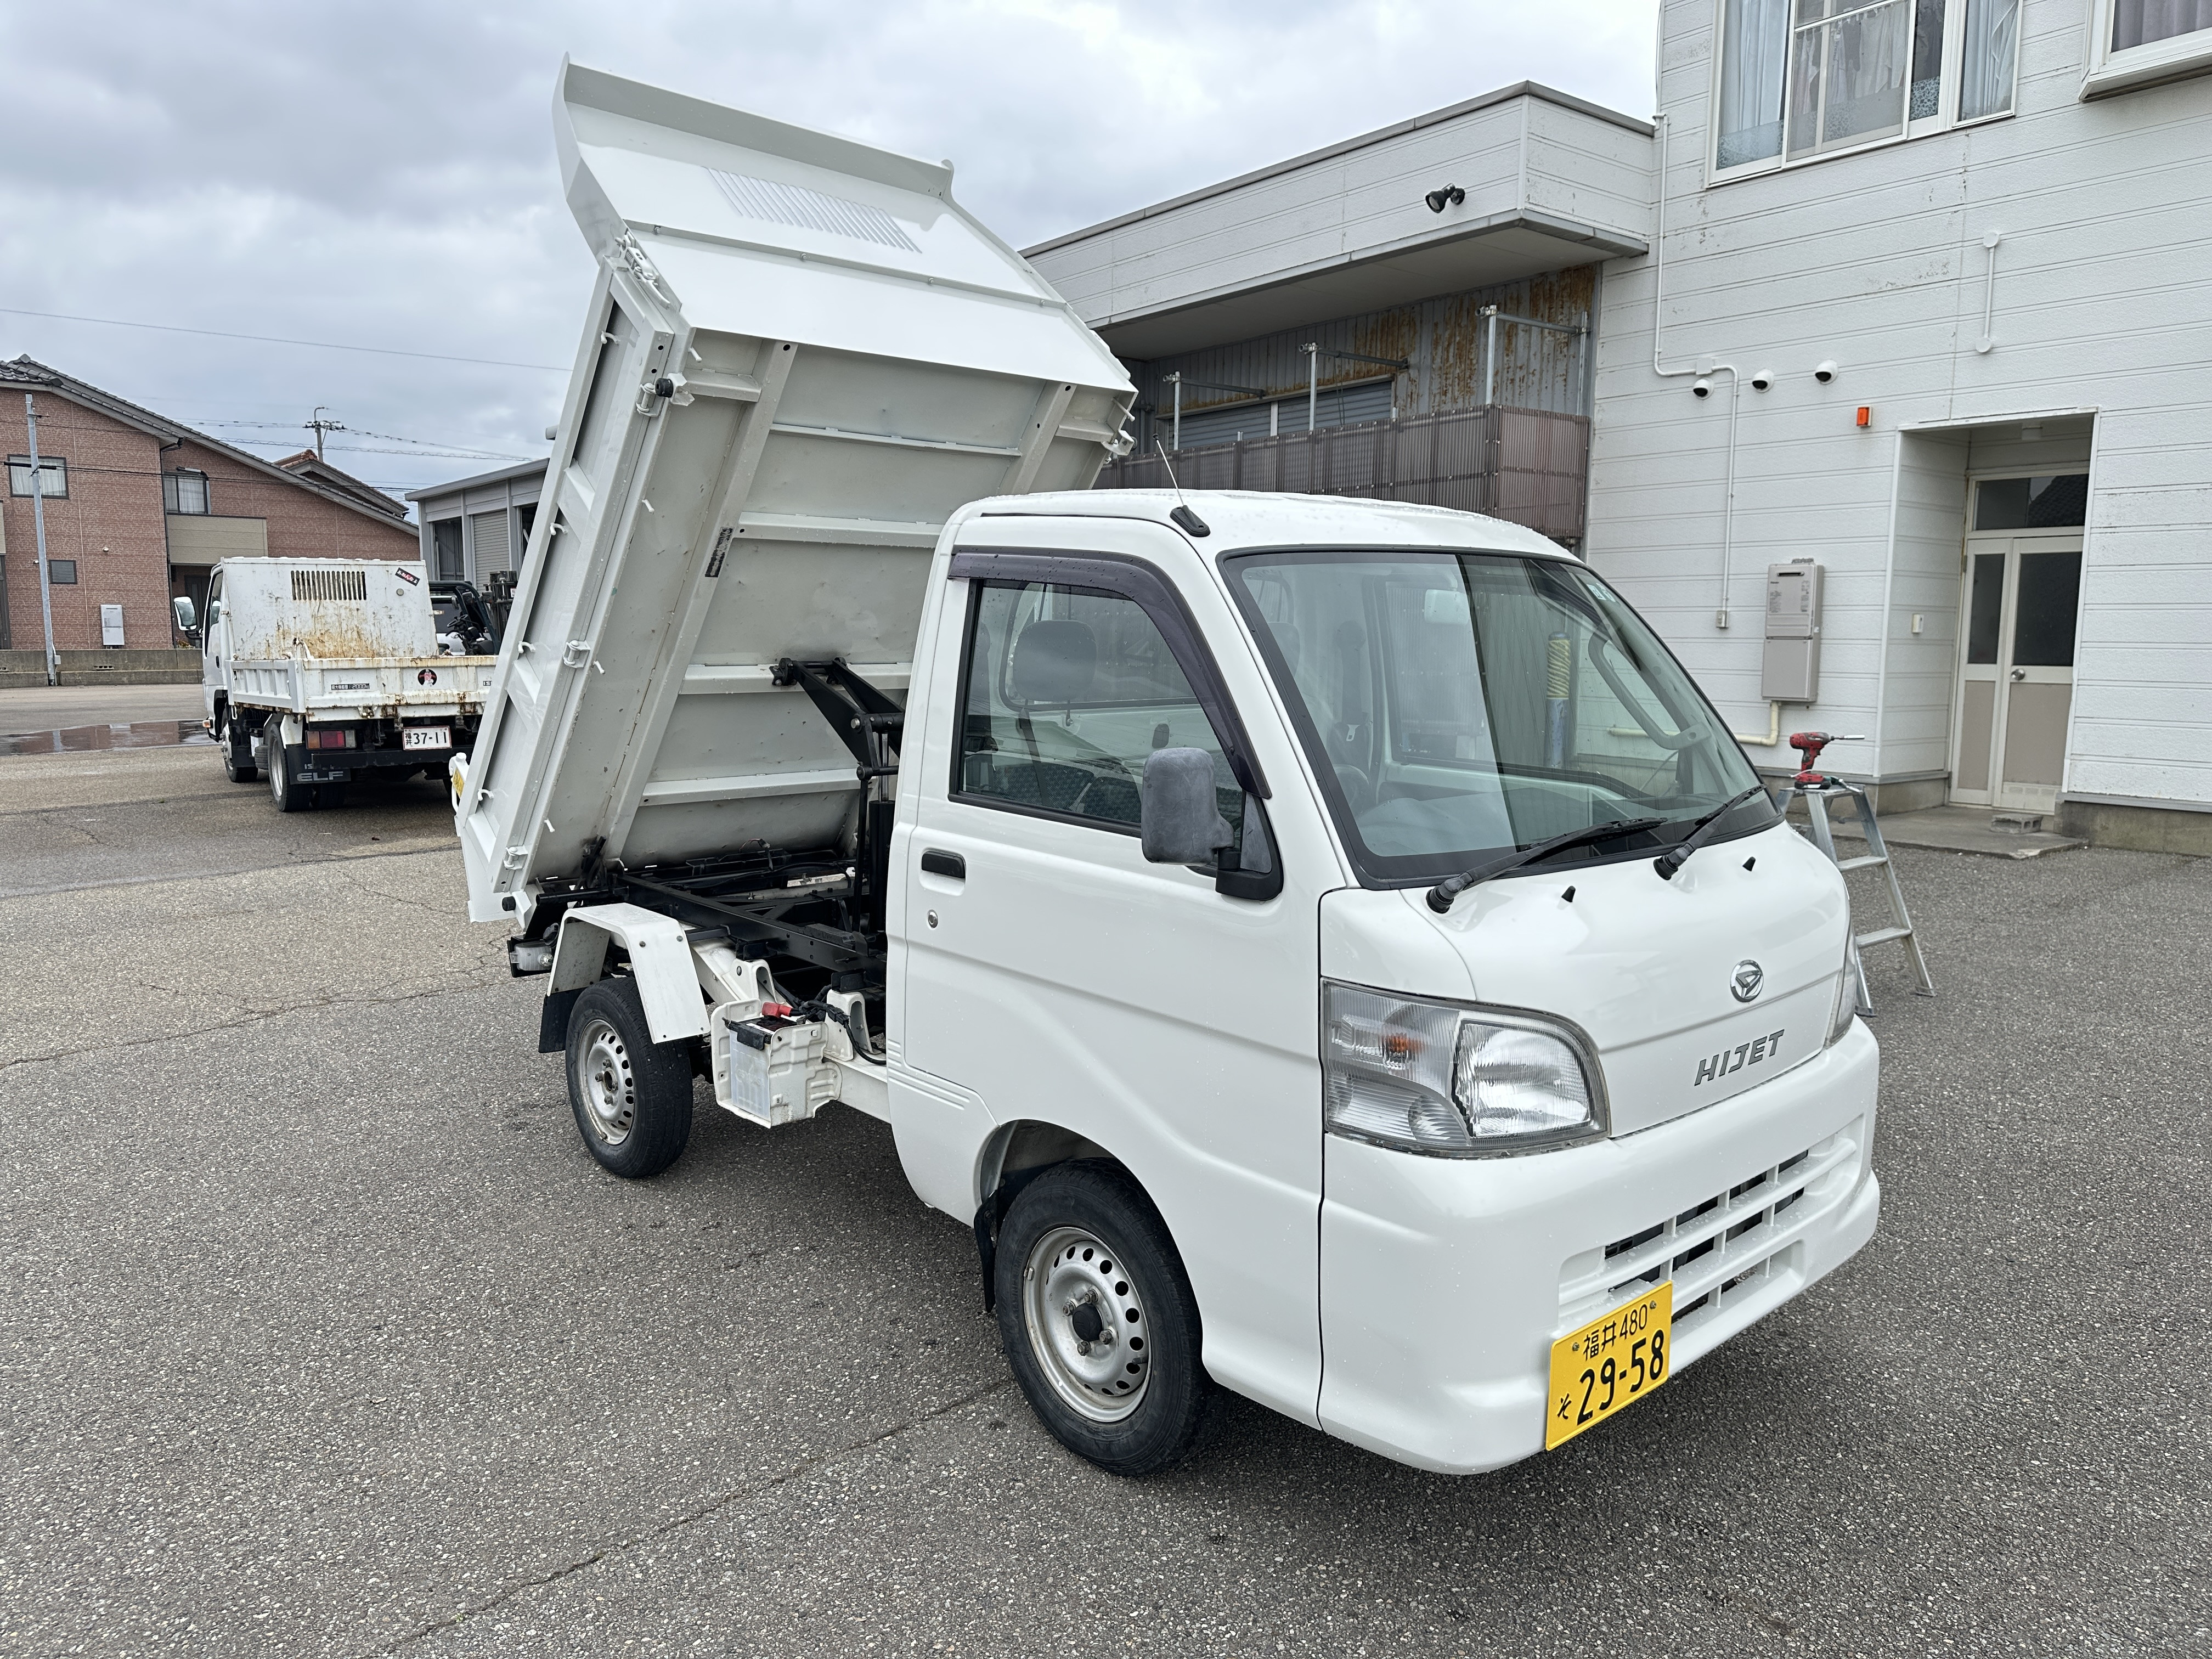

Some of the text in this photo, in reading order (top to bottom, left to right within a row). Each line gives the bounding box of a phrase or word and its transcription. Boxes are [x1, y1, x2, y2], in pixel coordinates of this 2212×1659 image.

[413, 731, 447, 744] 37-11
[297, 771, 343, 782] ELF
[1694, 1029, 1785, 1086] HIJET
[1557, 1329, 1664, 1425] そ 29-58
